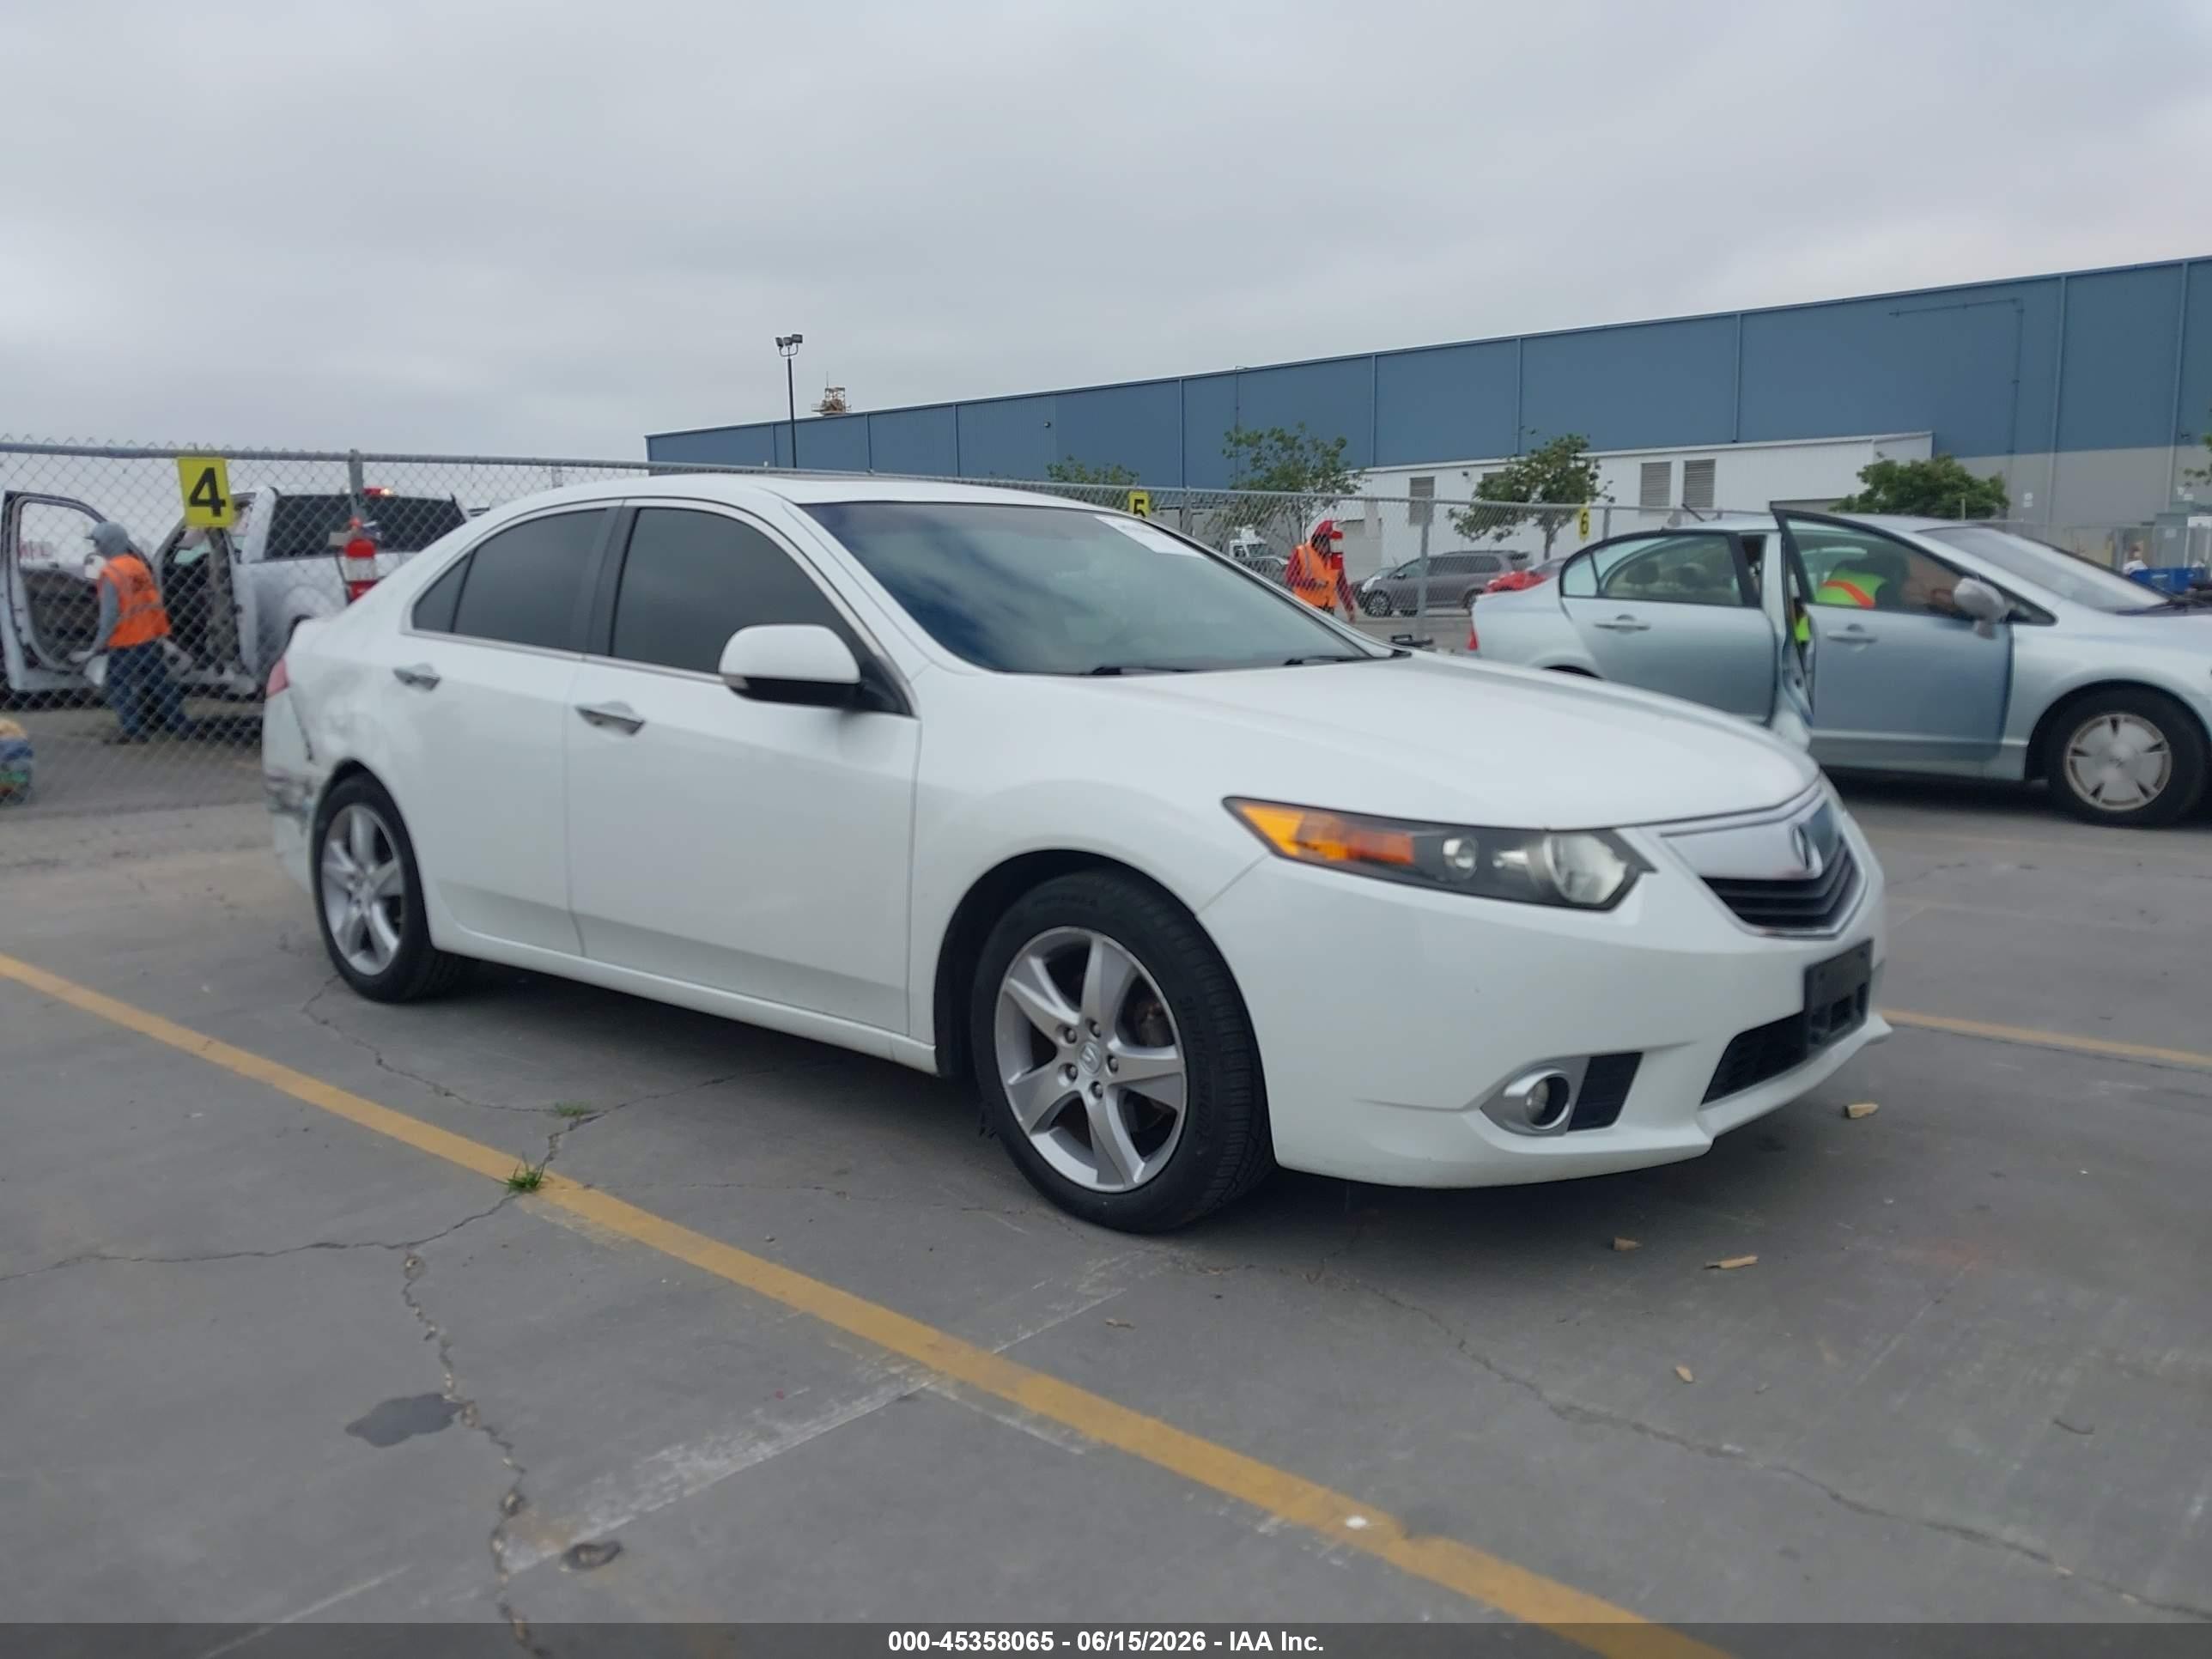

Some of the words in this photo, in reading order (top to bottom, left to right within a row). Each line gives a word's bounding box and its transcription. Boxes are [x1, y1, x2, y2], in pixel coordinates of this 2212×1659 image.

[189, 467, 227, 517] 4
[1133, 499, 1146, 518] 5
[1580, 512, 1589, 534] 6
